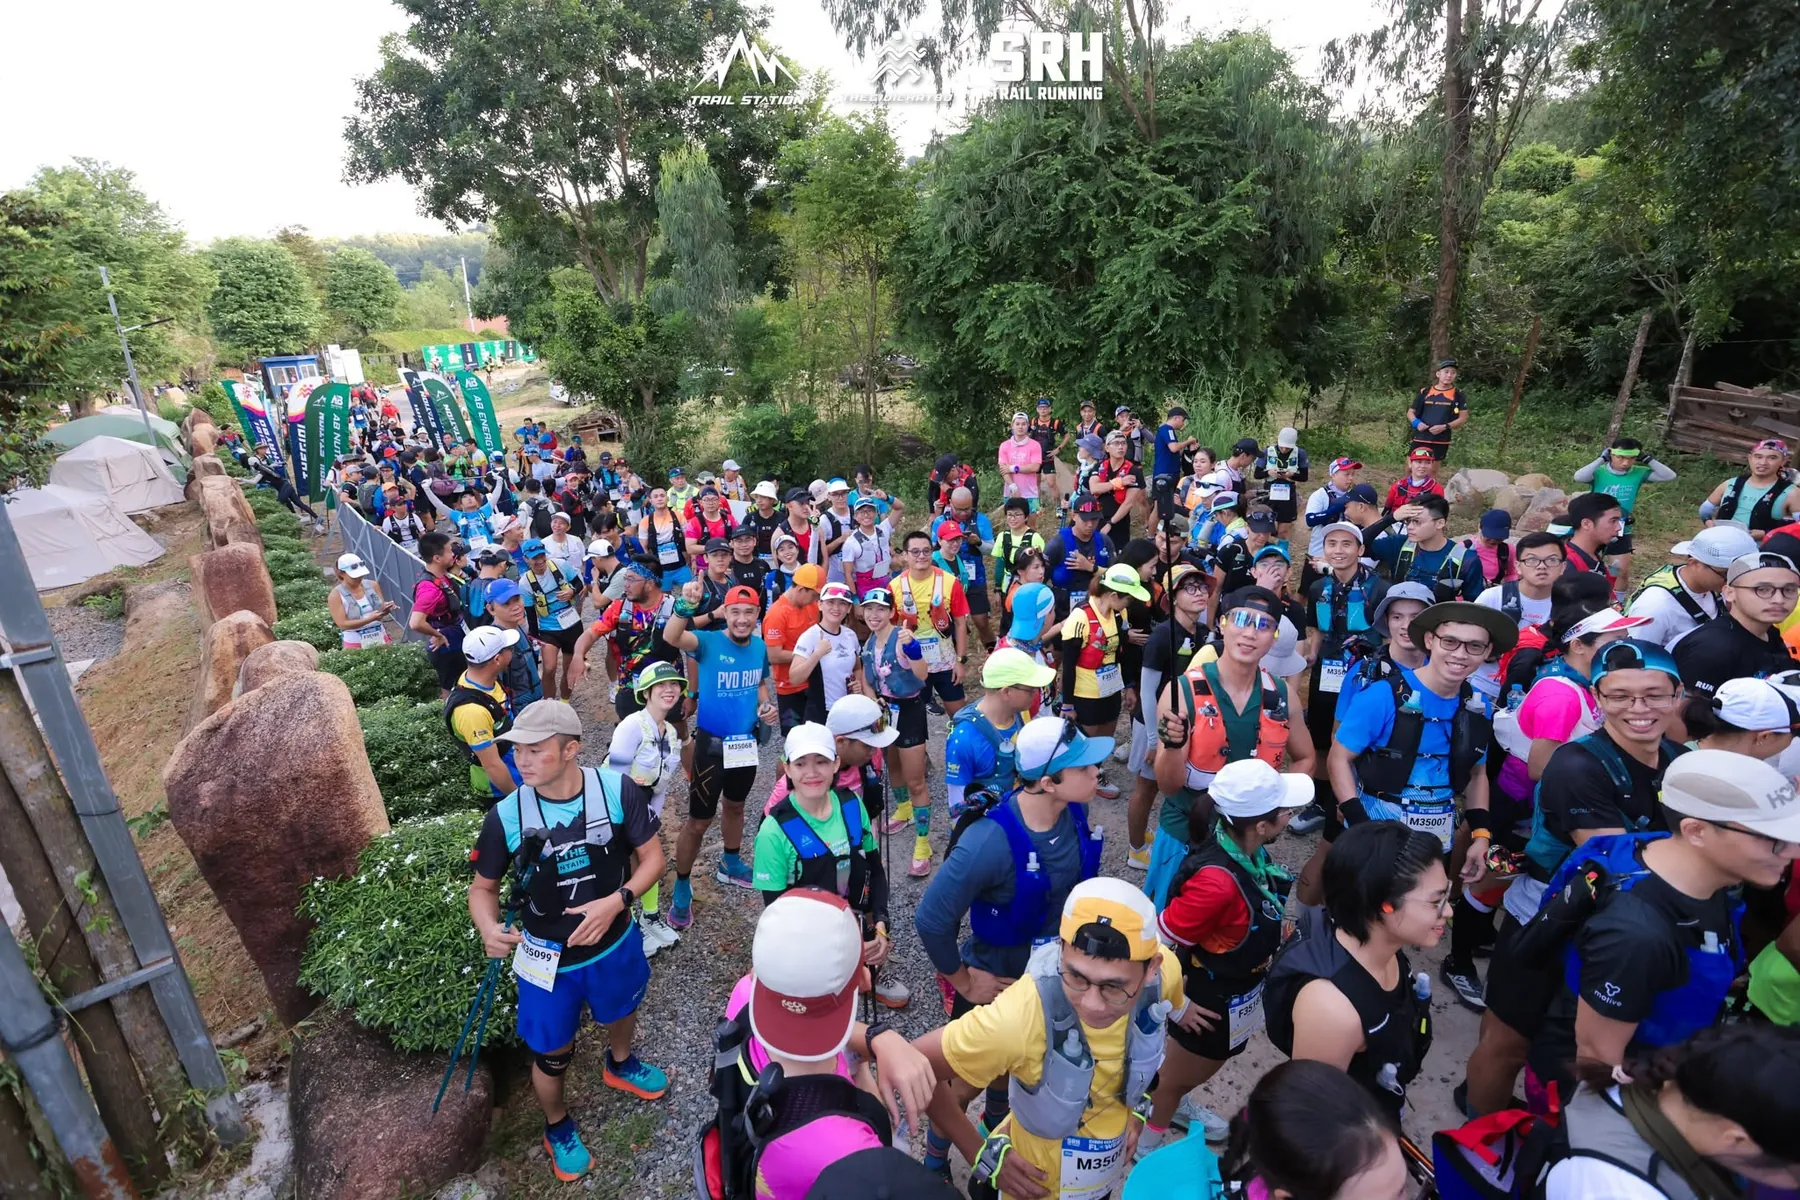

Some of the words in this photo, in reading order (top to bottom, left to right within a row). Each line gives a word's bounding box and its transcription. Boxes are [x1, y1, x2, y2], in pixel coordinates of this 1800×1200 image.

[473, 394, 484, 410] AB
[332, 413, 341, 430] AB
[478, 412, 495, 452] ENERGY
[717, 671, 740, 690] PVD
[1694, 680, 1715, 693] RUN
[1409, 817, 1447, 827] M35007
[564, 846, 587, 860] THE
[560, 859, 585, 871] NTAIN
[1594, 990, 1622, 1007] motive
